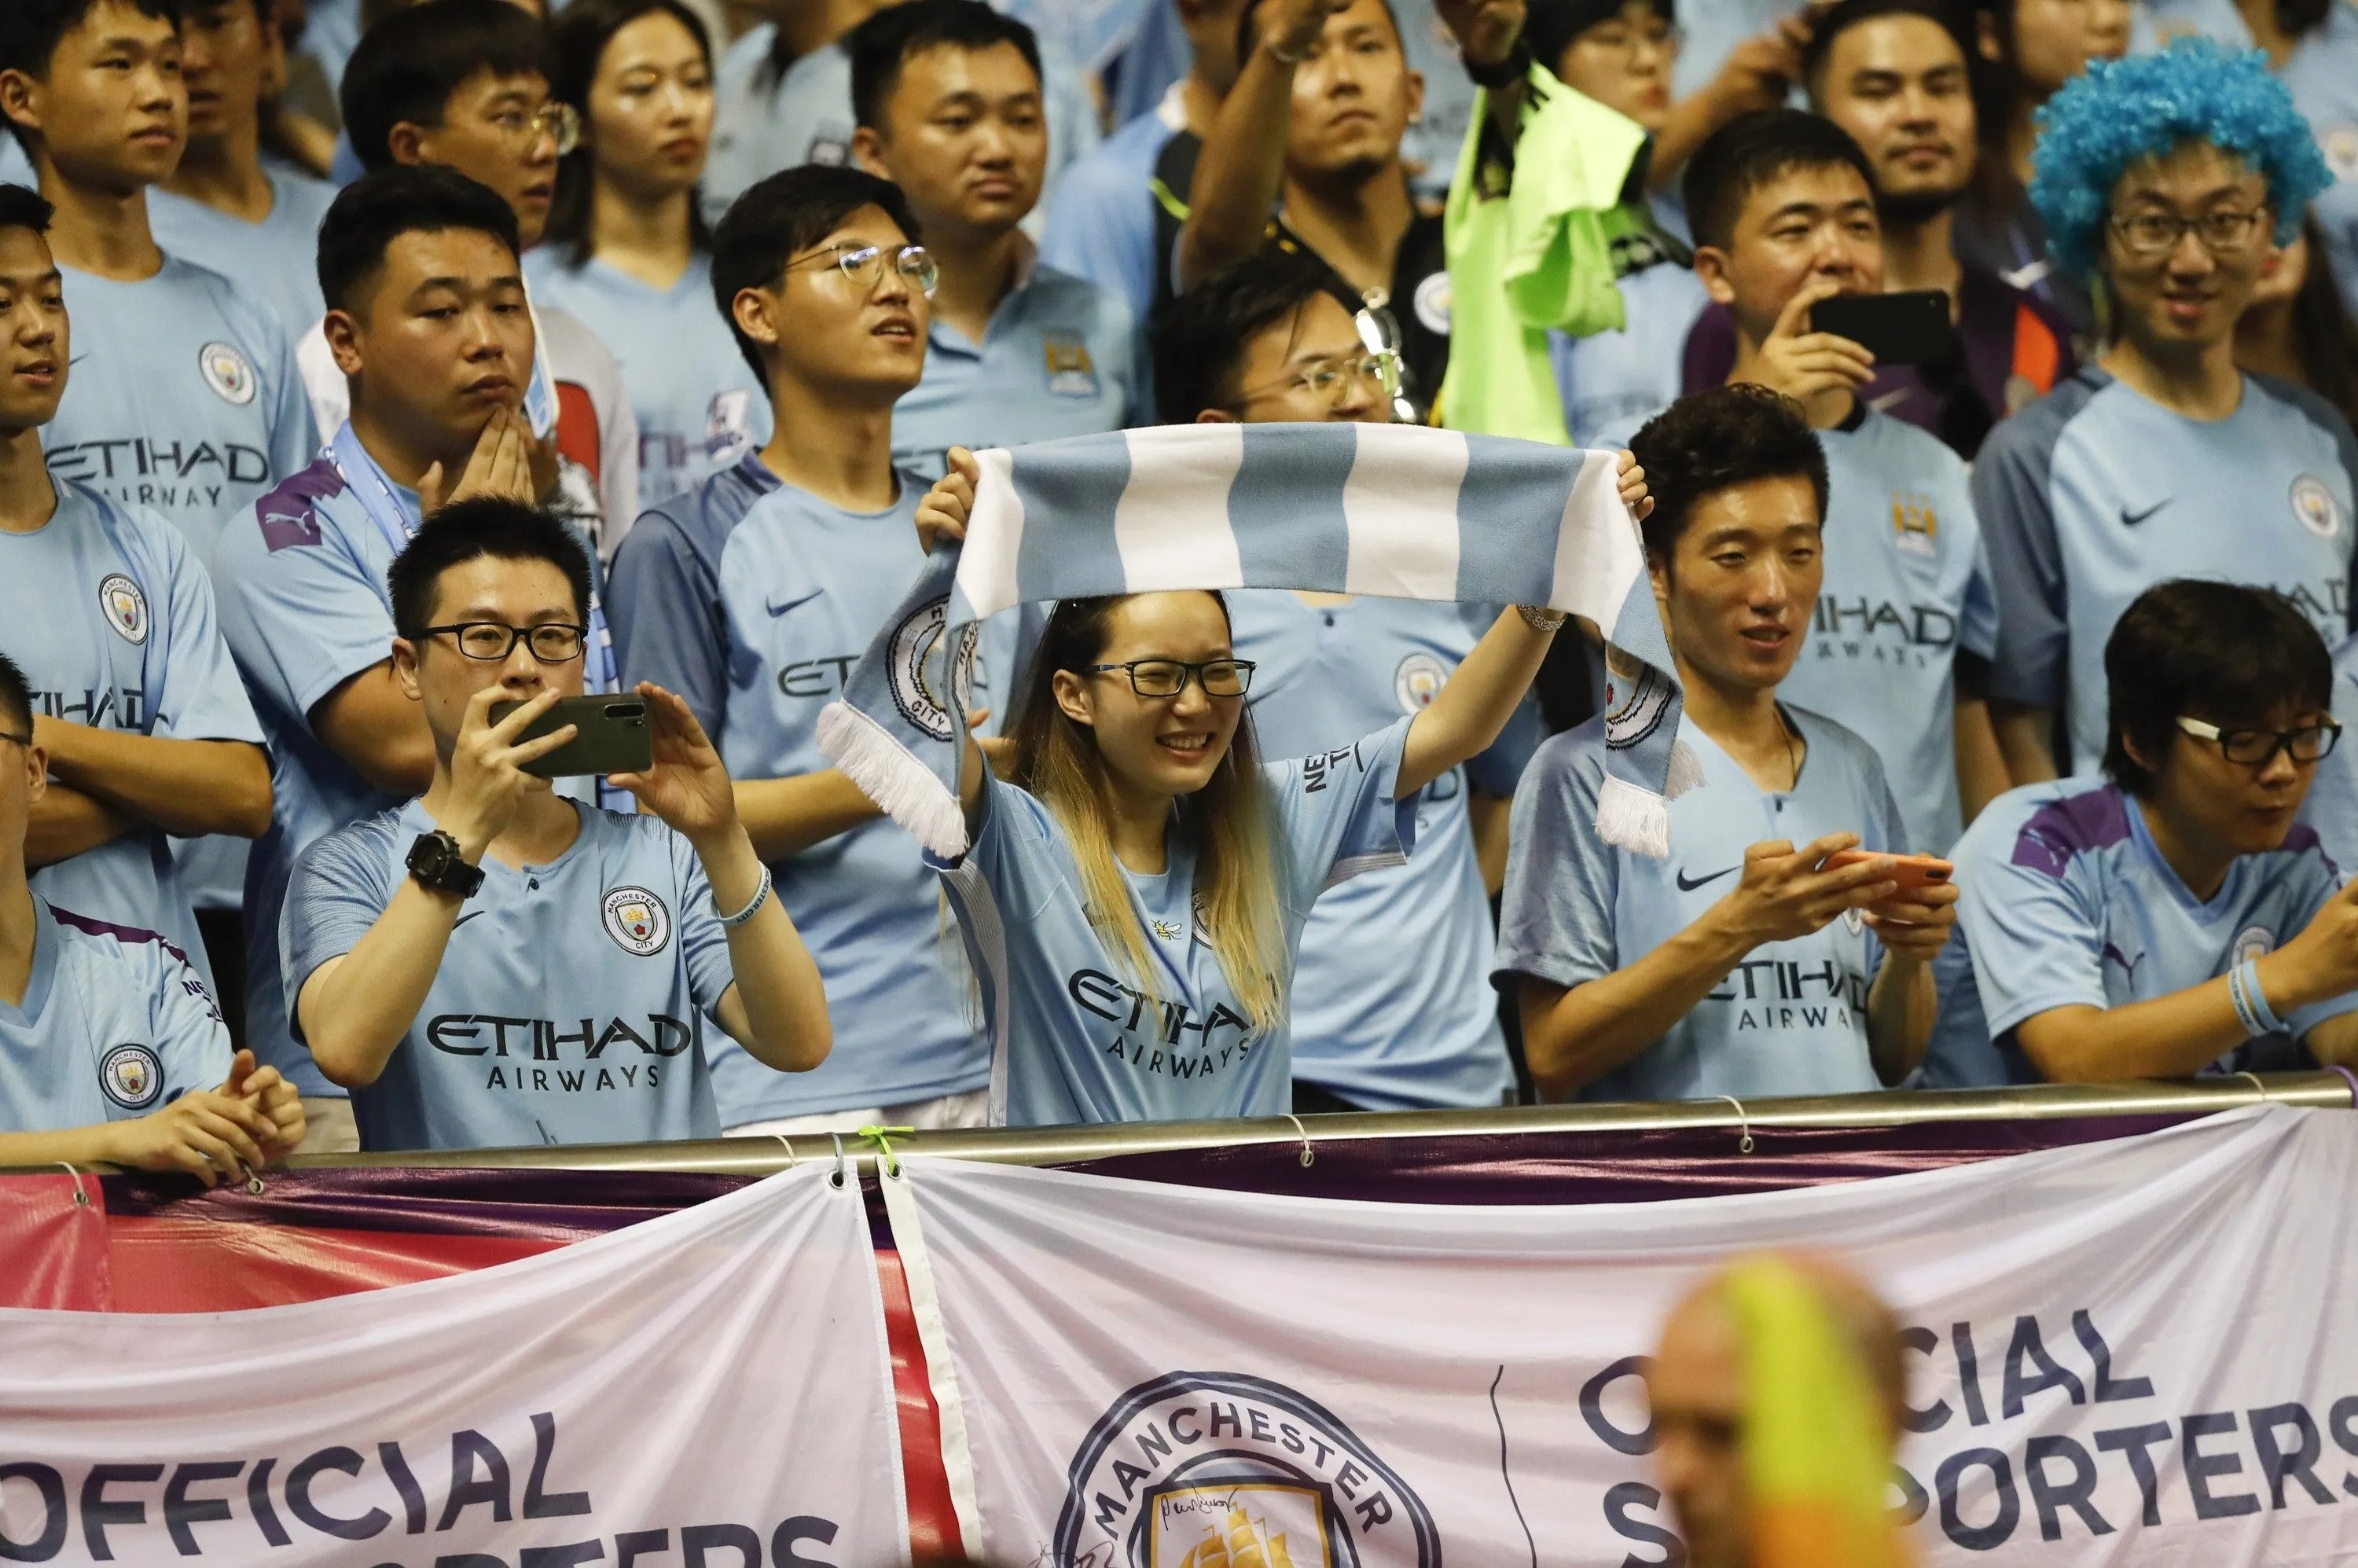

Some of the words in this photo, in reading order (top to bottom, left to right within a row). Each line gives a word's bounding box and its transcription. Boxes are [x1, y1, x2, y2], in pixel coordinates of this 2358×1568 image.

[43, 437, 269, 484] ETIHAD
[1816, 595, 1956, 647] IHAD
[912, 700, 945, 726] CITY
[608, 893, 656, 913] MANCHESTER
[427, 1013, 692, 1061] ETIHAD
[1738, 1006, 1850, 1031] AIRWA
[108, 1052, 151, 1071] MANCHESTER
[487, 1065, 659, 1092] AIRWAYS
[1107, 1036, 1250, 1079] AIRWAYS
[1578, 1309, 2155, 1456] OCIAL
[0, 1411, 591, 1562] OFFICIAL
[1094, 1401, 1394, 1540] MANCHESTER
